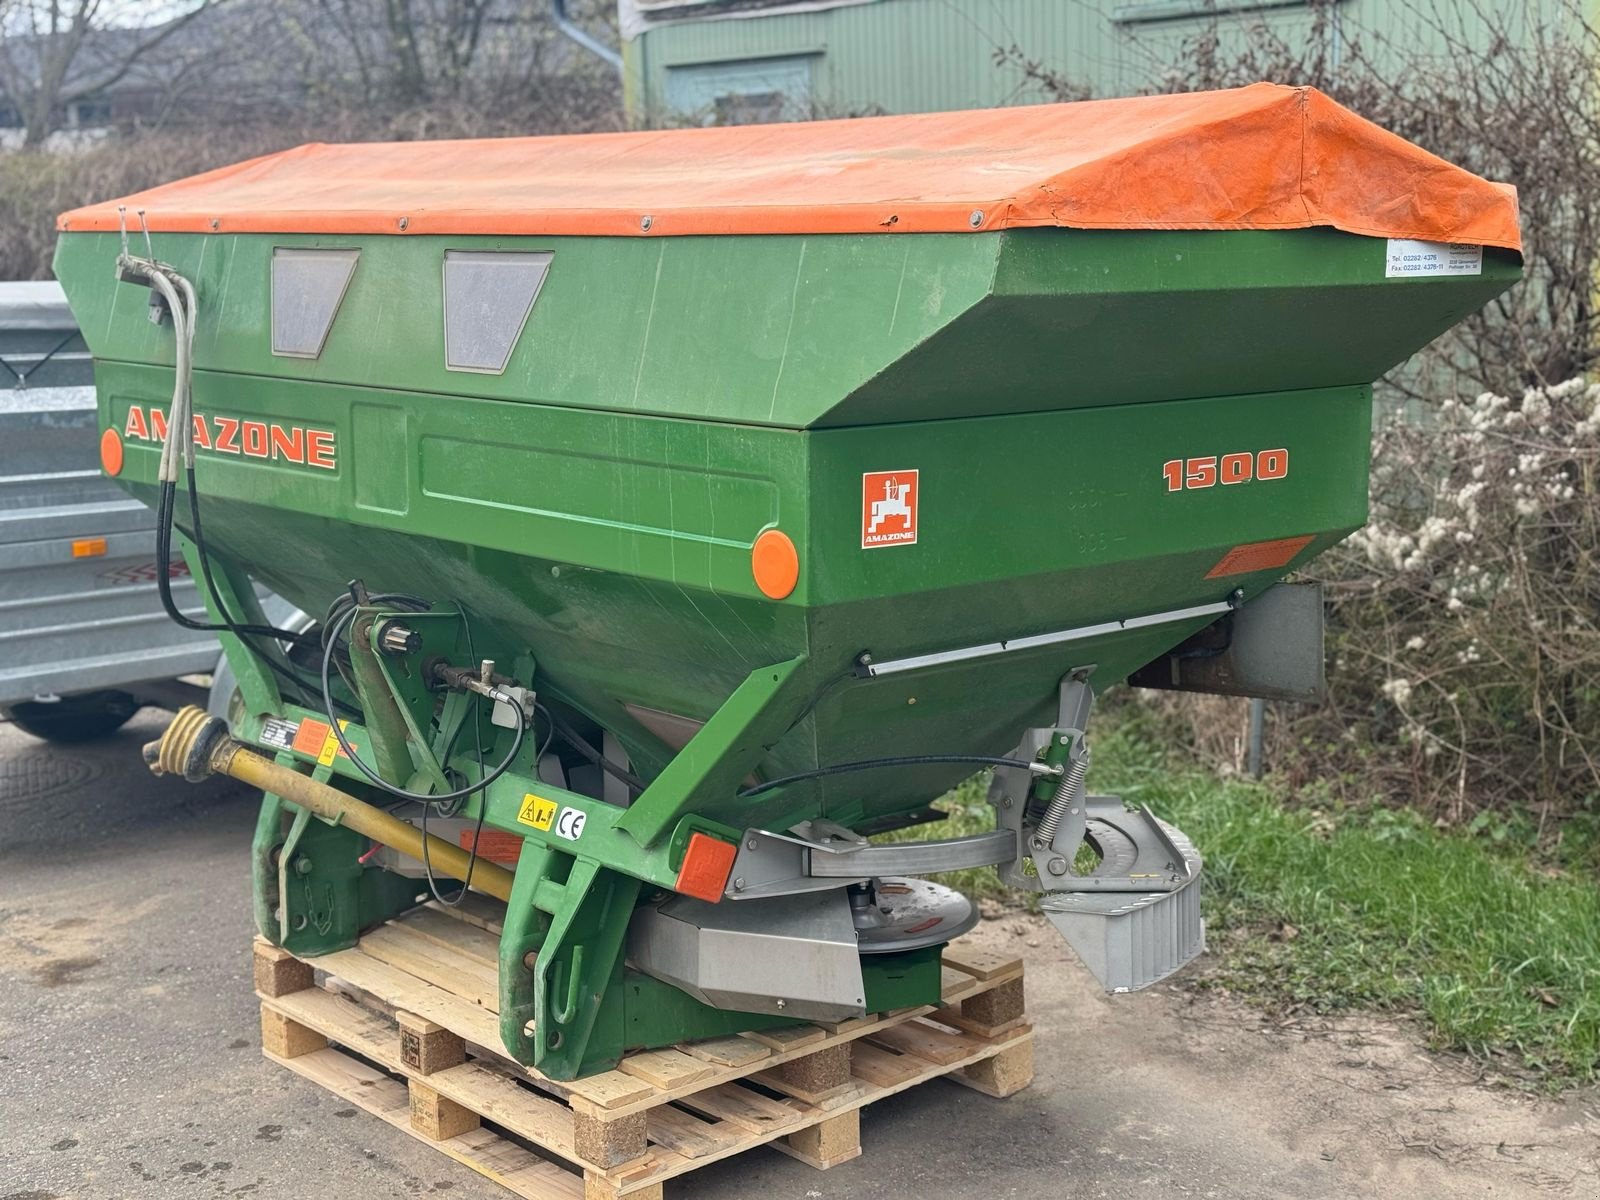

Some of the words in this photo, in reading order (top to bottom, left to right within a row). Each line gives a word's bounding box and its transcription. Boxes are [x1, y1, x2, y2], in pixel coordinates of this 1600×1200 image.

[1163, 448, 1289, 492] 1500
[865, 531, 915, 543] AMAZONE
[559, 811, 584, 839] CE
